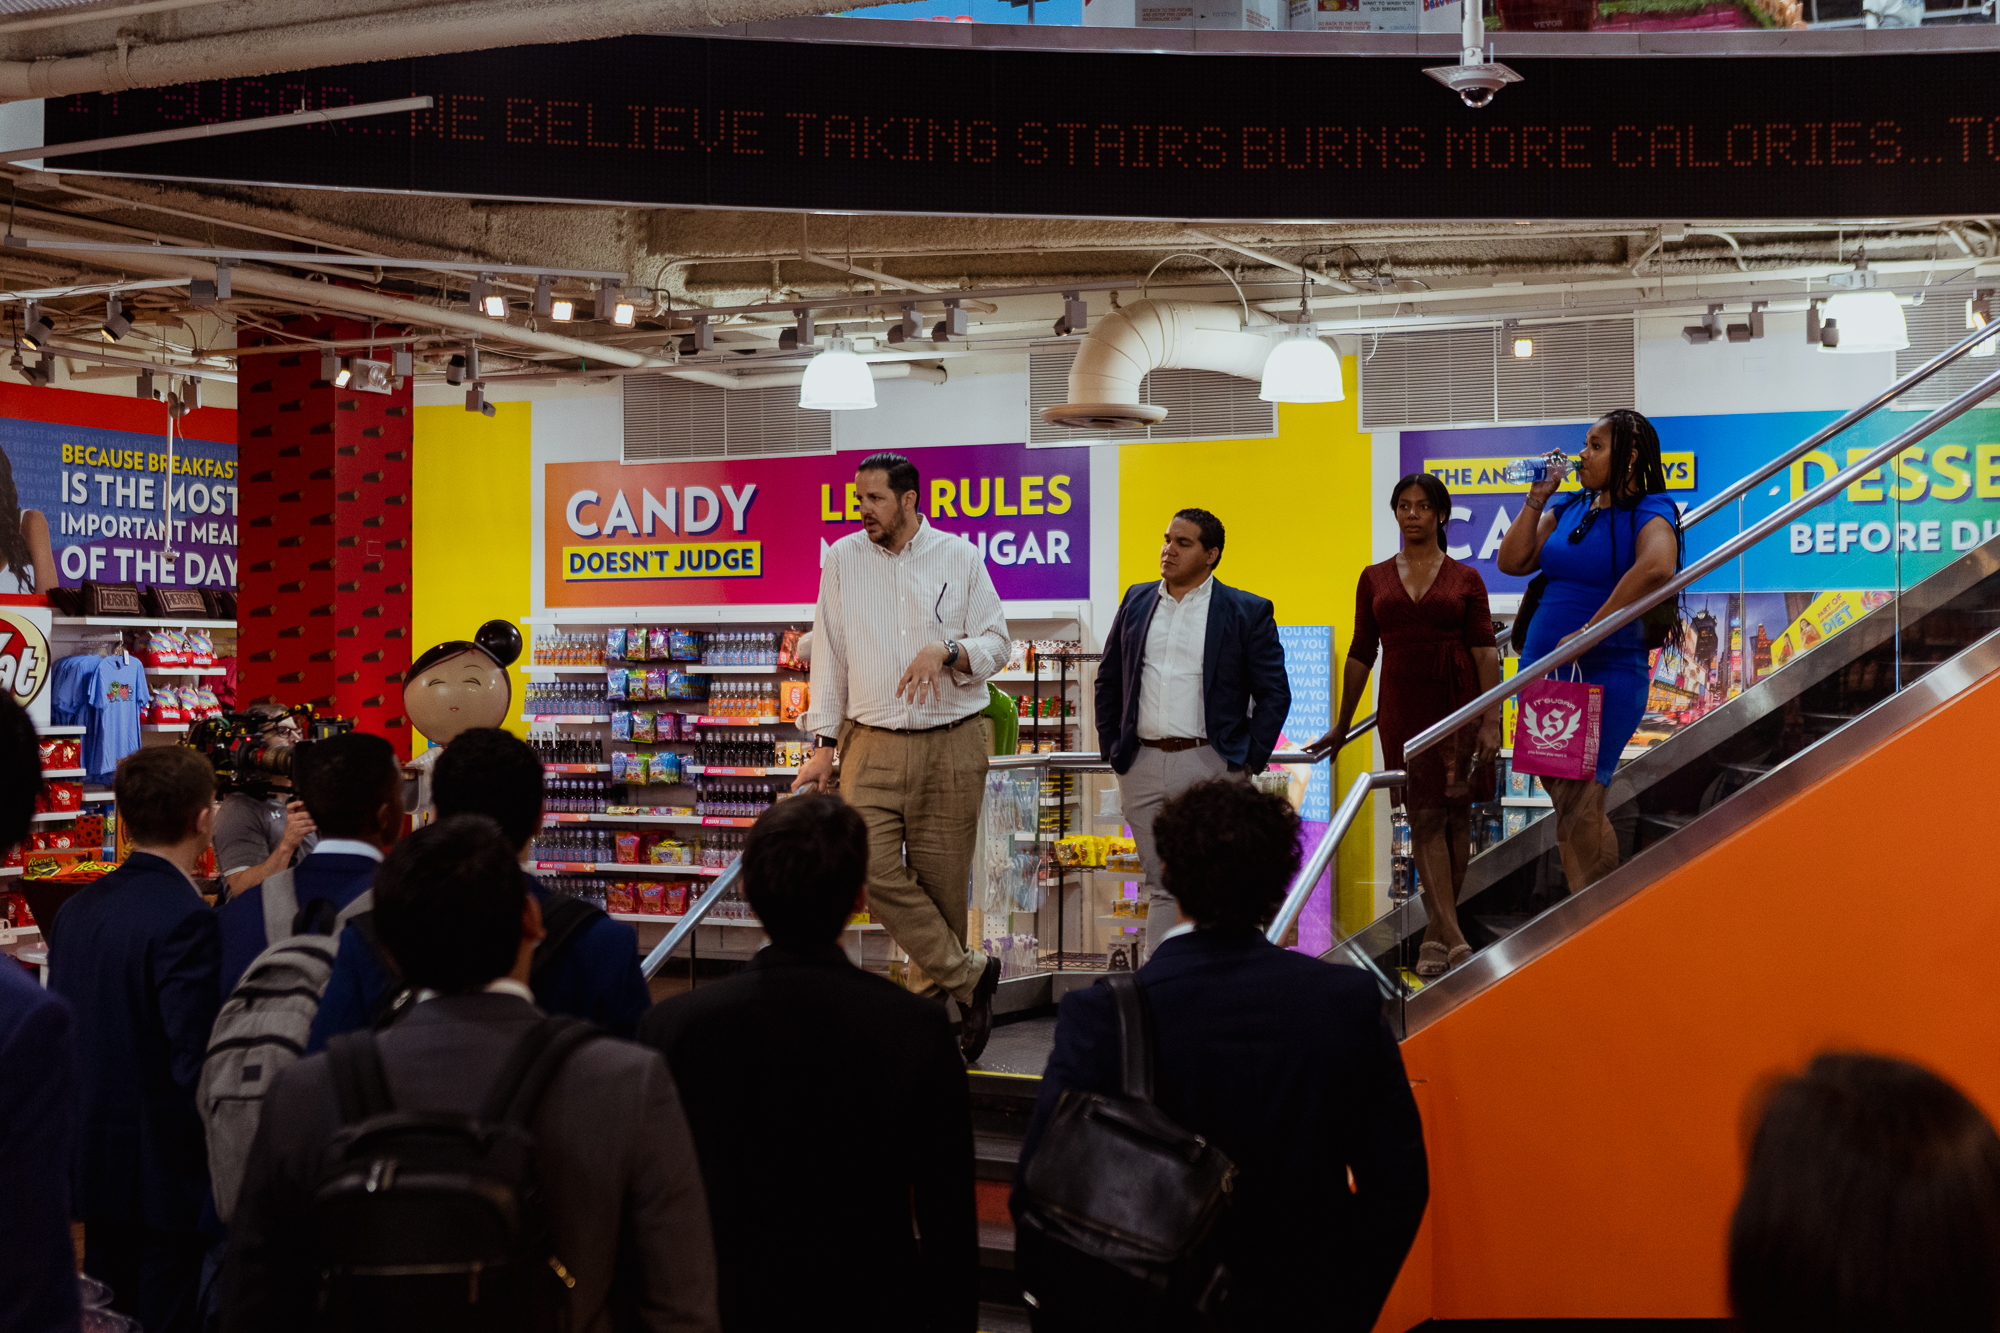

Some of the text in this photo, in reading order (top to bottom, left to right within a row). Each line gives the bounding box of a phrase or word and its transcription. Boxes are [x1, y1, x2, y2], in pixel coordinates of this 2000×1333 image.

[506, 98, 765, 154] BELIEVE
[786, 112, 997, 163] TAKING
[1018, 122, 1227, 169] STAIRS
[1243, 126, 1425, 169] BURNS
[1446, 126, 1592, 169] MORE
[61, 443, 144, 471] BECAUSE
[1430, 467, 1473, 486] THE
[61, 471, 238, 517] IS THE MOST
[930, 474, 1073, 520] RULES
[566, 484, 759, 538] CANDY
[60, 511, 187, 543] IMPORTANT
[1790, 520, 2000, 555] BEFORE DI
[673, 548, 755, 573] JUDGE
[962, 530, 1072, 567] GAR
[61, 545, 238, 587] OF THE DAY
[1278, 627, 1302, 636] YOU
[1821, 604, 1853, 635] DIET
[1293, 652, 1329, 662] WANT
[1301, 639, 1327, 649] YOU
[1293, 678, 1329, 687] WANT
[1292, 704, 1328, 714] WANT
[1305, 783, 1329, 793] ANT
